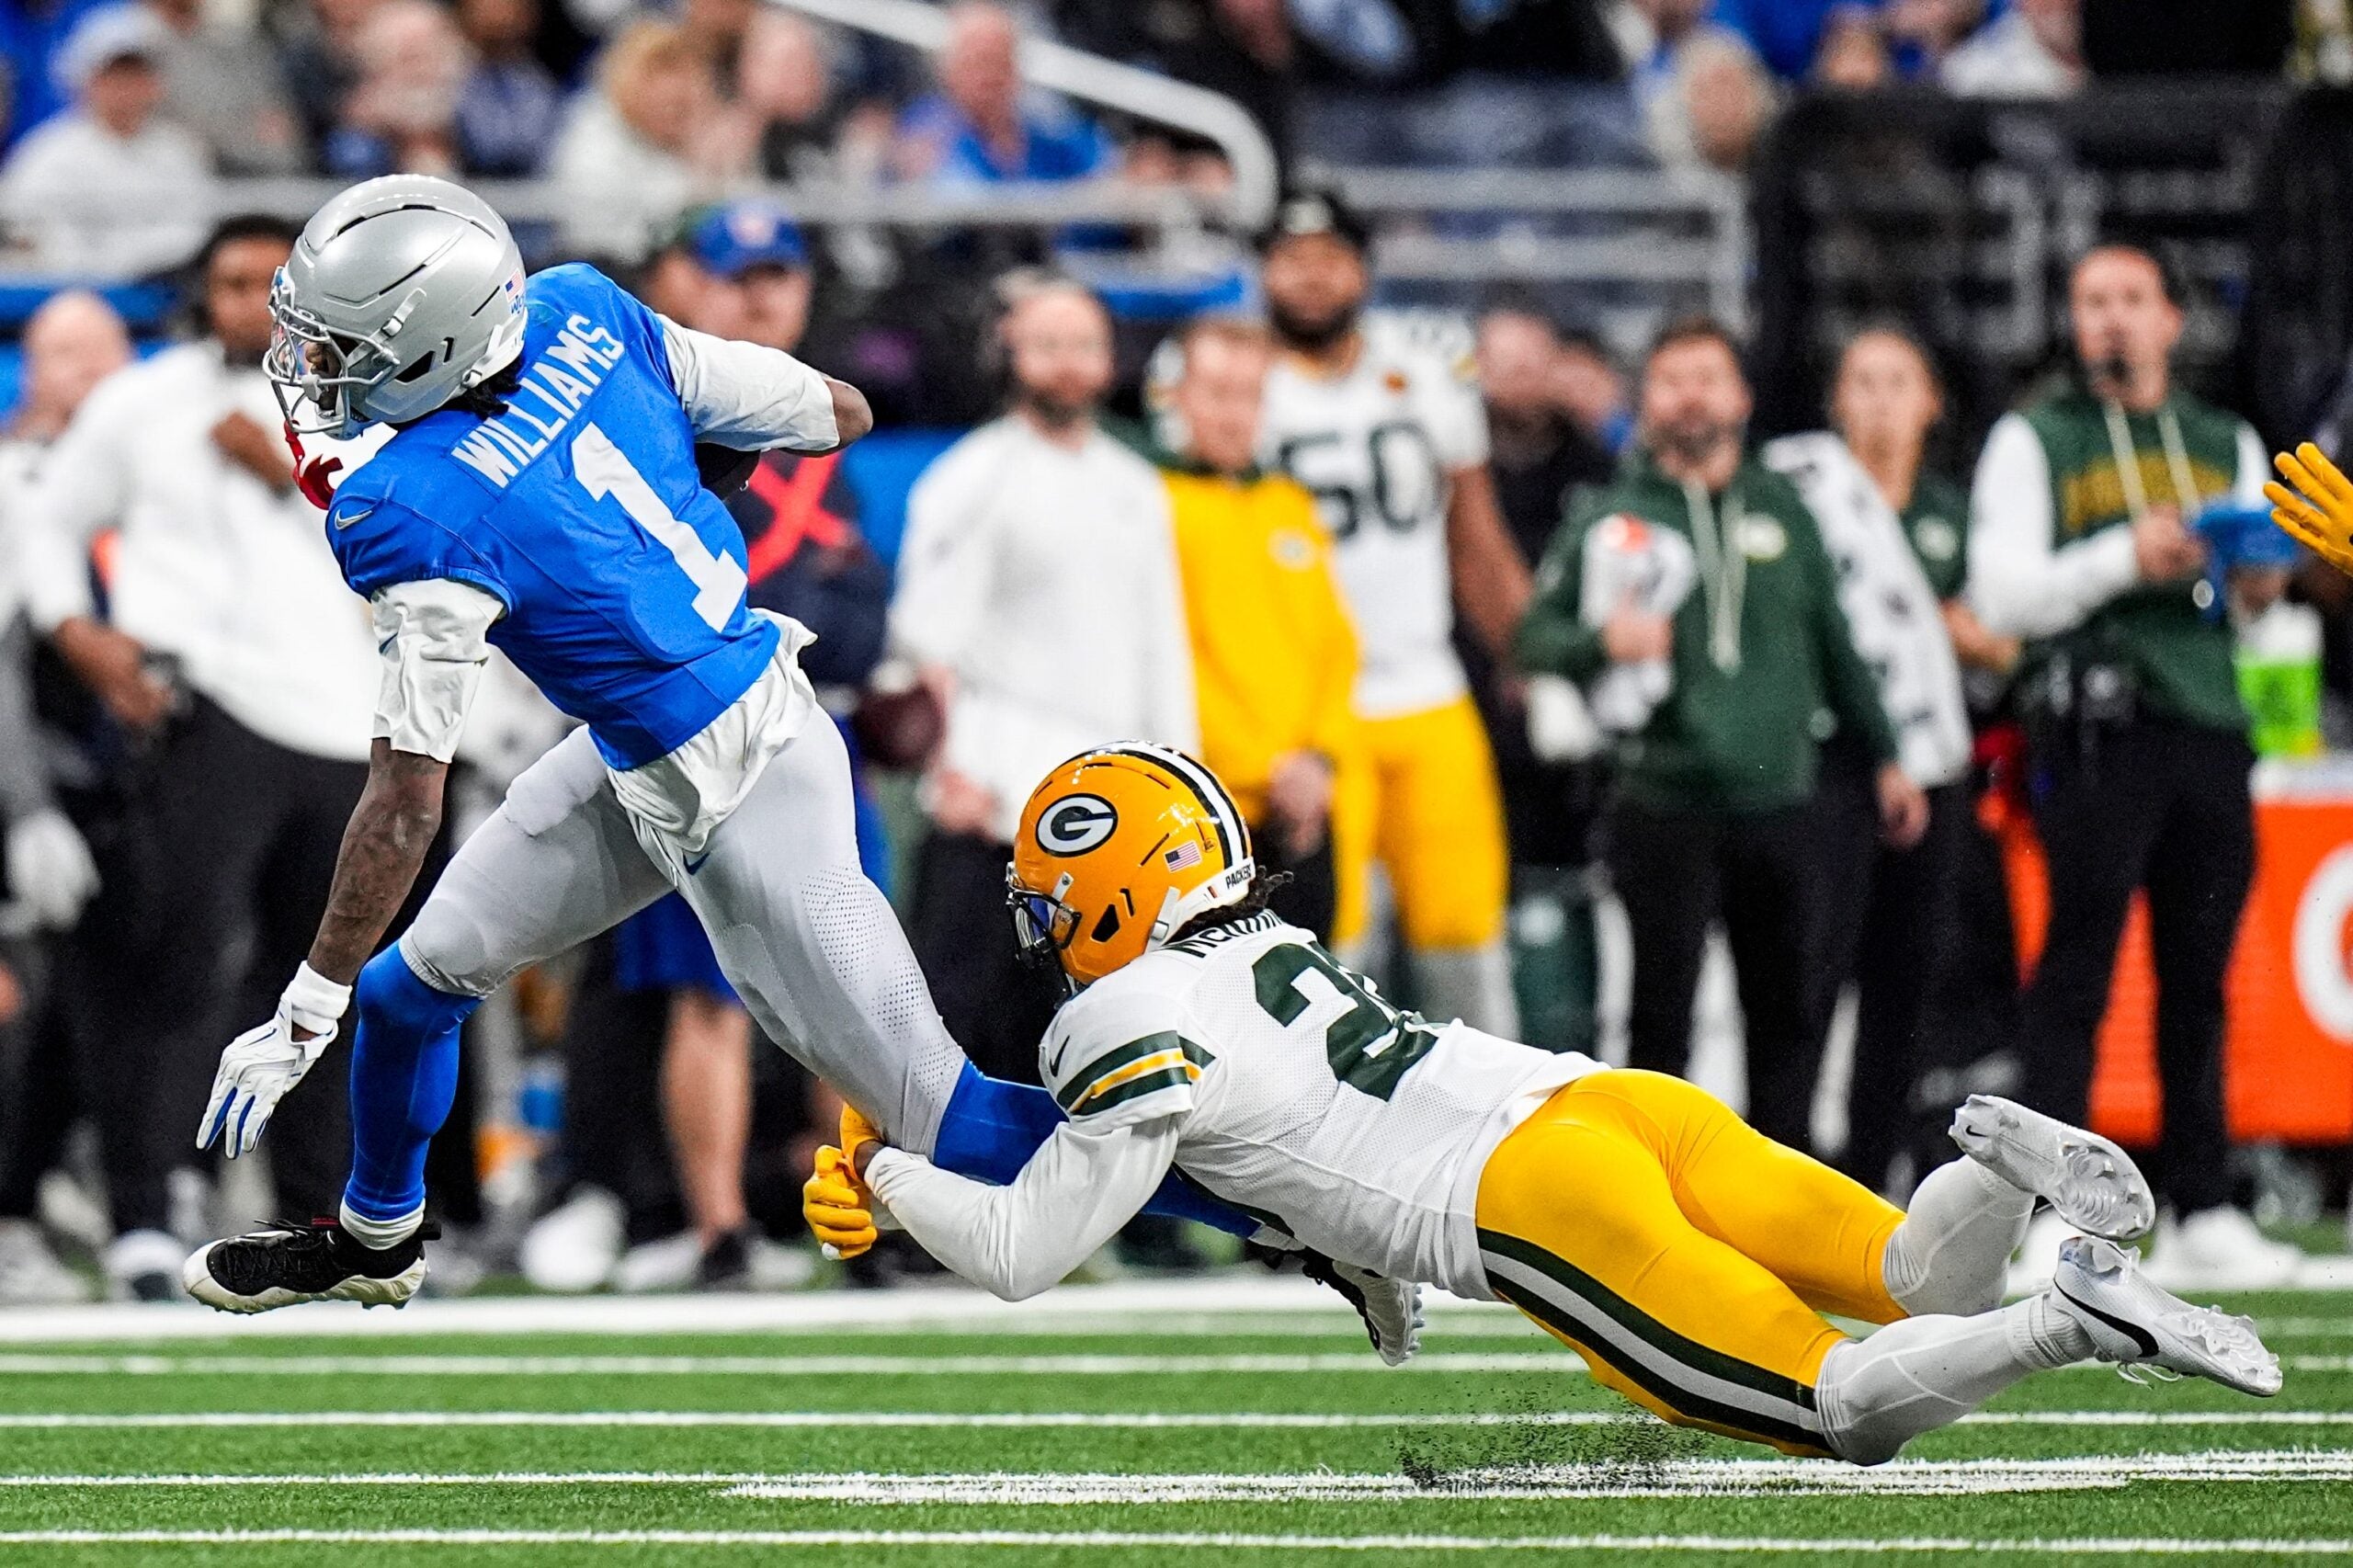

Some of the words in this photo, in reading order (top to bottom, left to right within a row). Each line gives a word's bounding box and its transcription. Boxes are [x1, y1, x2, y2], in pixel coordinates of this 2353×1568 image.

[450, 314, 625, 488] WILLIAMS
[571, 420, 748, 633] 1
[1279, 420, 1438, 540] 50
[1036, 795, 1116, 855] G
